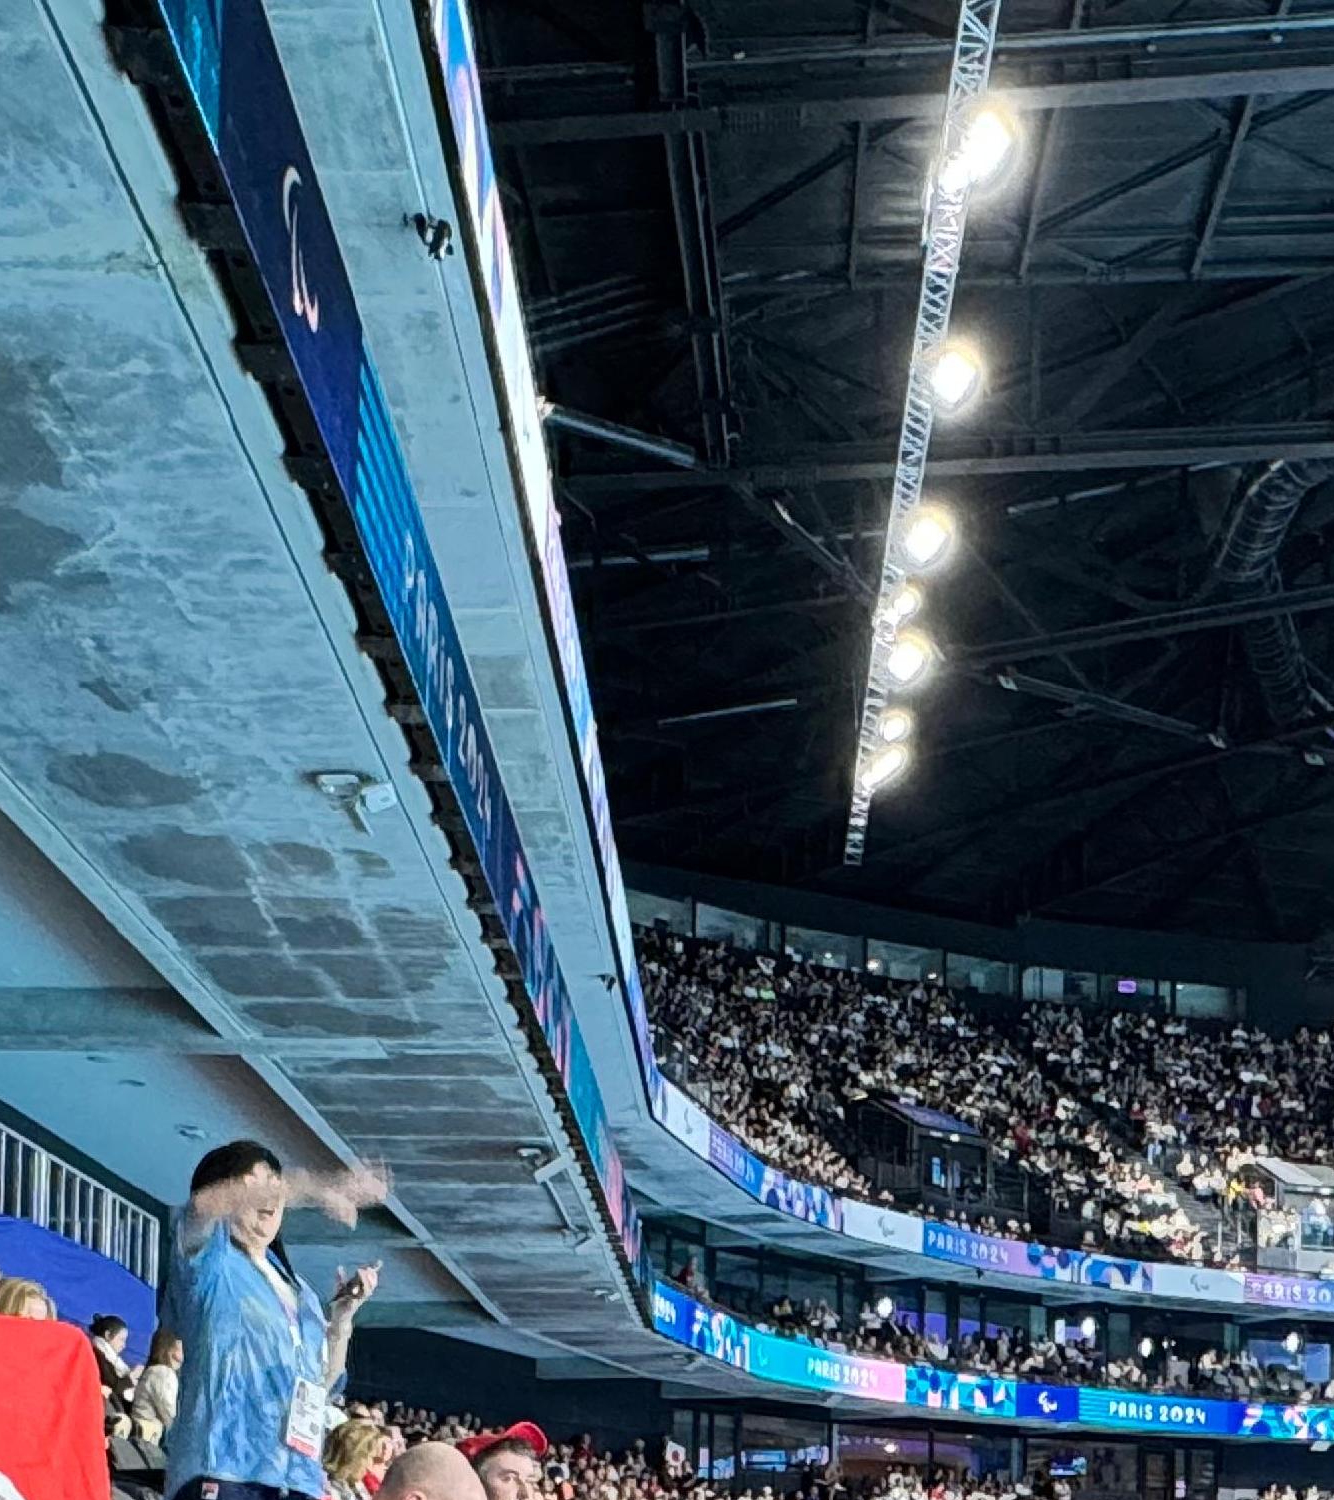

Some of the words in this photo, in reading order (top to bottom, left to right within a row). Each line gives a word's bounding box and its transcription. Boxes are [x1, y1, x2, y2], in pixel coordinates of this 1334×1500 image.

[928, 1229, 966, 1255] PARIS
[971, 1240, 1008, 1264] 2024
[1251, 1280, 1301, 1302] PARIS
[807, 1357, 840, 1381] PARIS
[845, 1367, 877, 1387] 2024
[1109, 1400, 1152, 1420] PARIS
[1160, 1405, 1205, 1424] 2024
